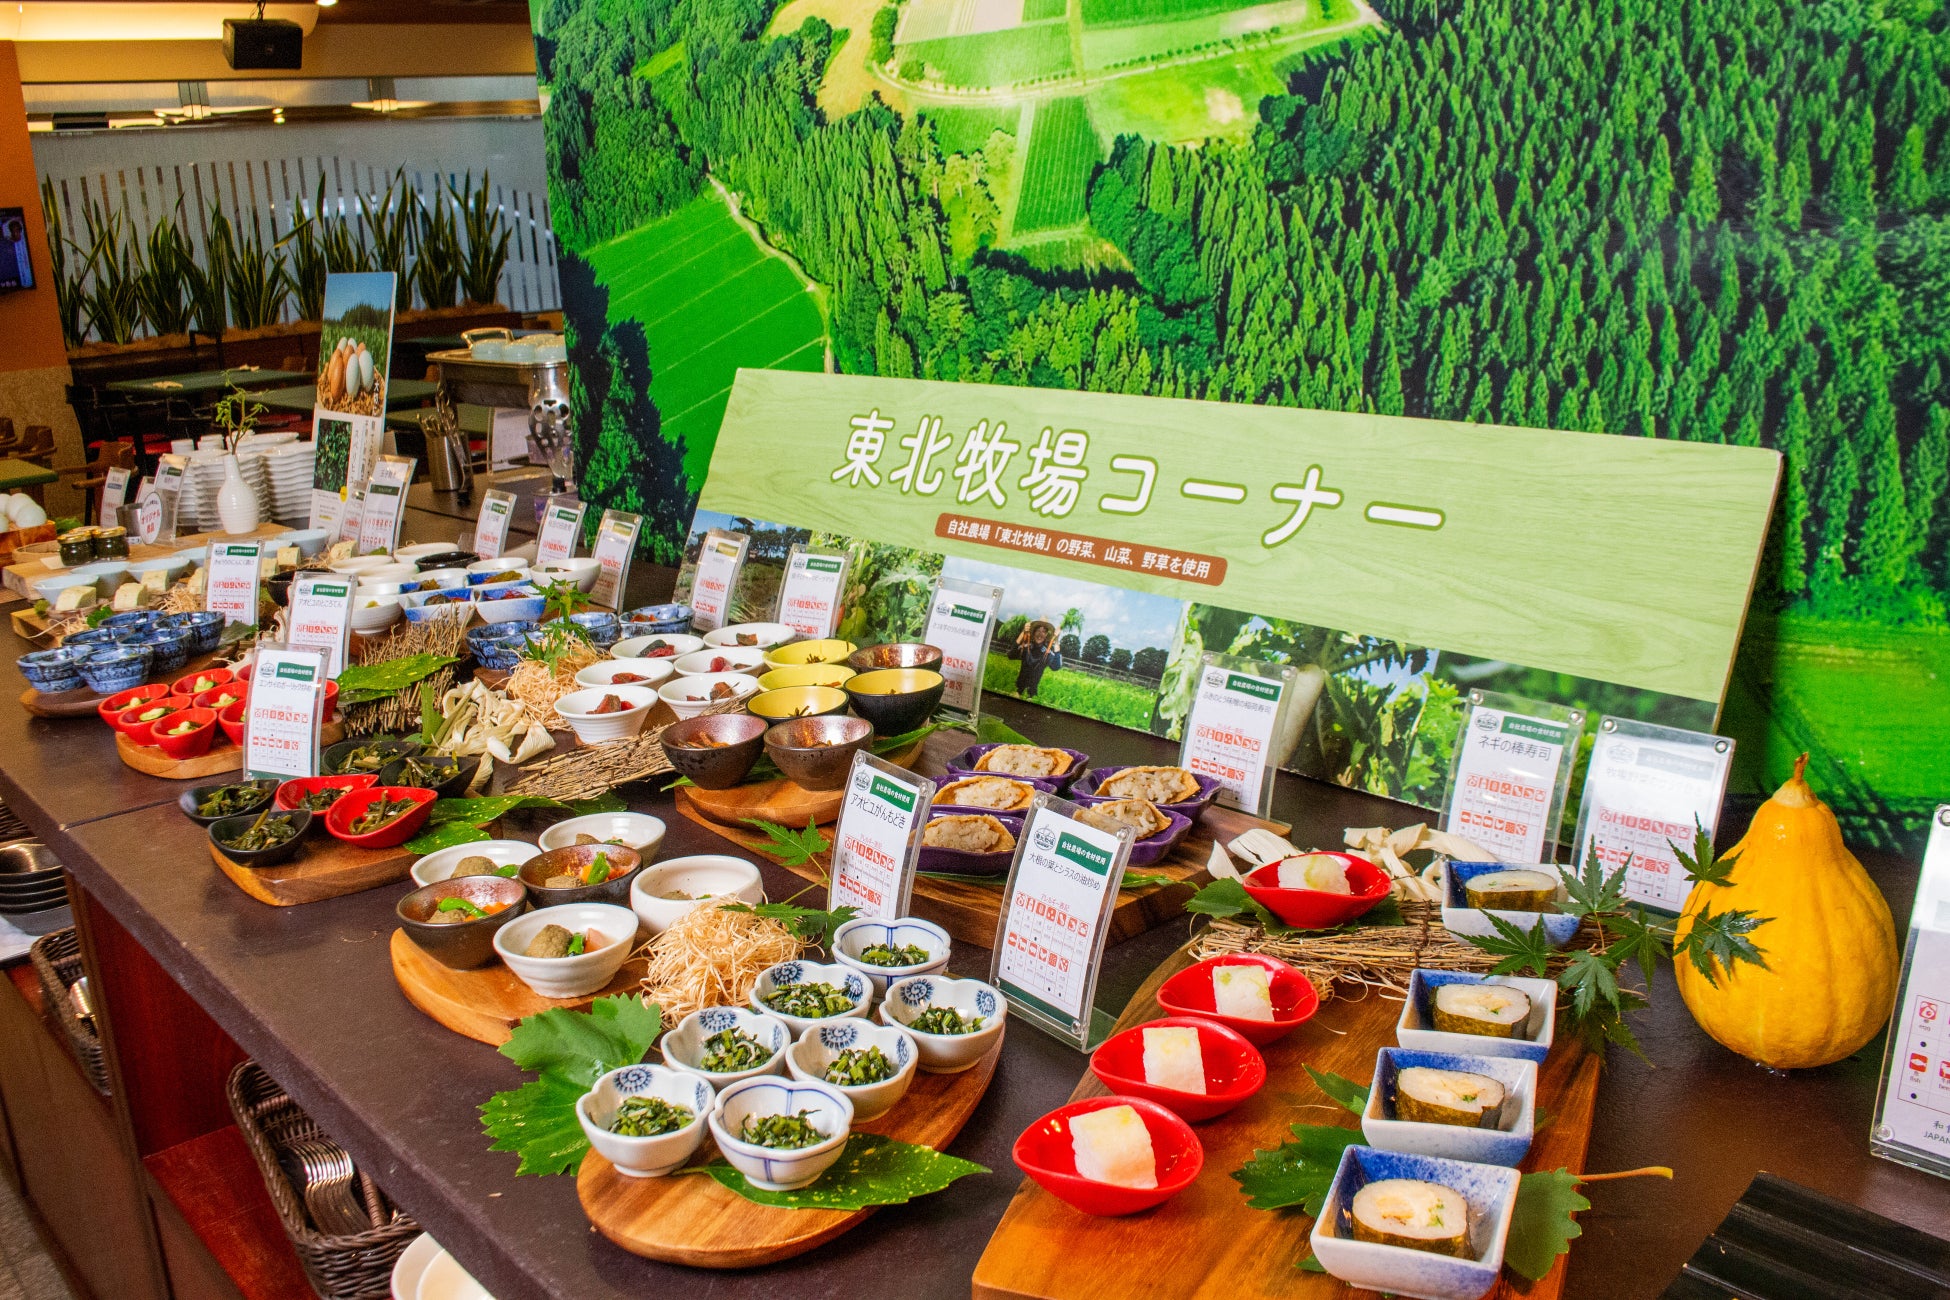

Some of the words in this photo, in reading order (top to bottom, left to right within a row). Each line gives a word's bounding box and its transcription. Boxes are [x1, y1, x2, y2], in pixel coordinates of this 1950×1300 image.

[832, 408, 1445, 548] 東北牧場コーナー
[946, 519, 1211, 579] 自社農場「東北牧場」の野菜、山菜、野草を使用
[1478, 735, 1553, 761] ネギの棒寿司
[850, 793, 907, 830] アオビユがんもどき
[1028, 852, 1101, 891] 大根の葉とシラスの油炒め
[1061, 840, 1107, 866] 自社農場の食材使用
